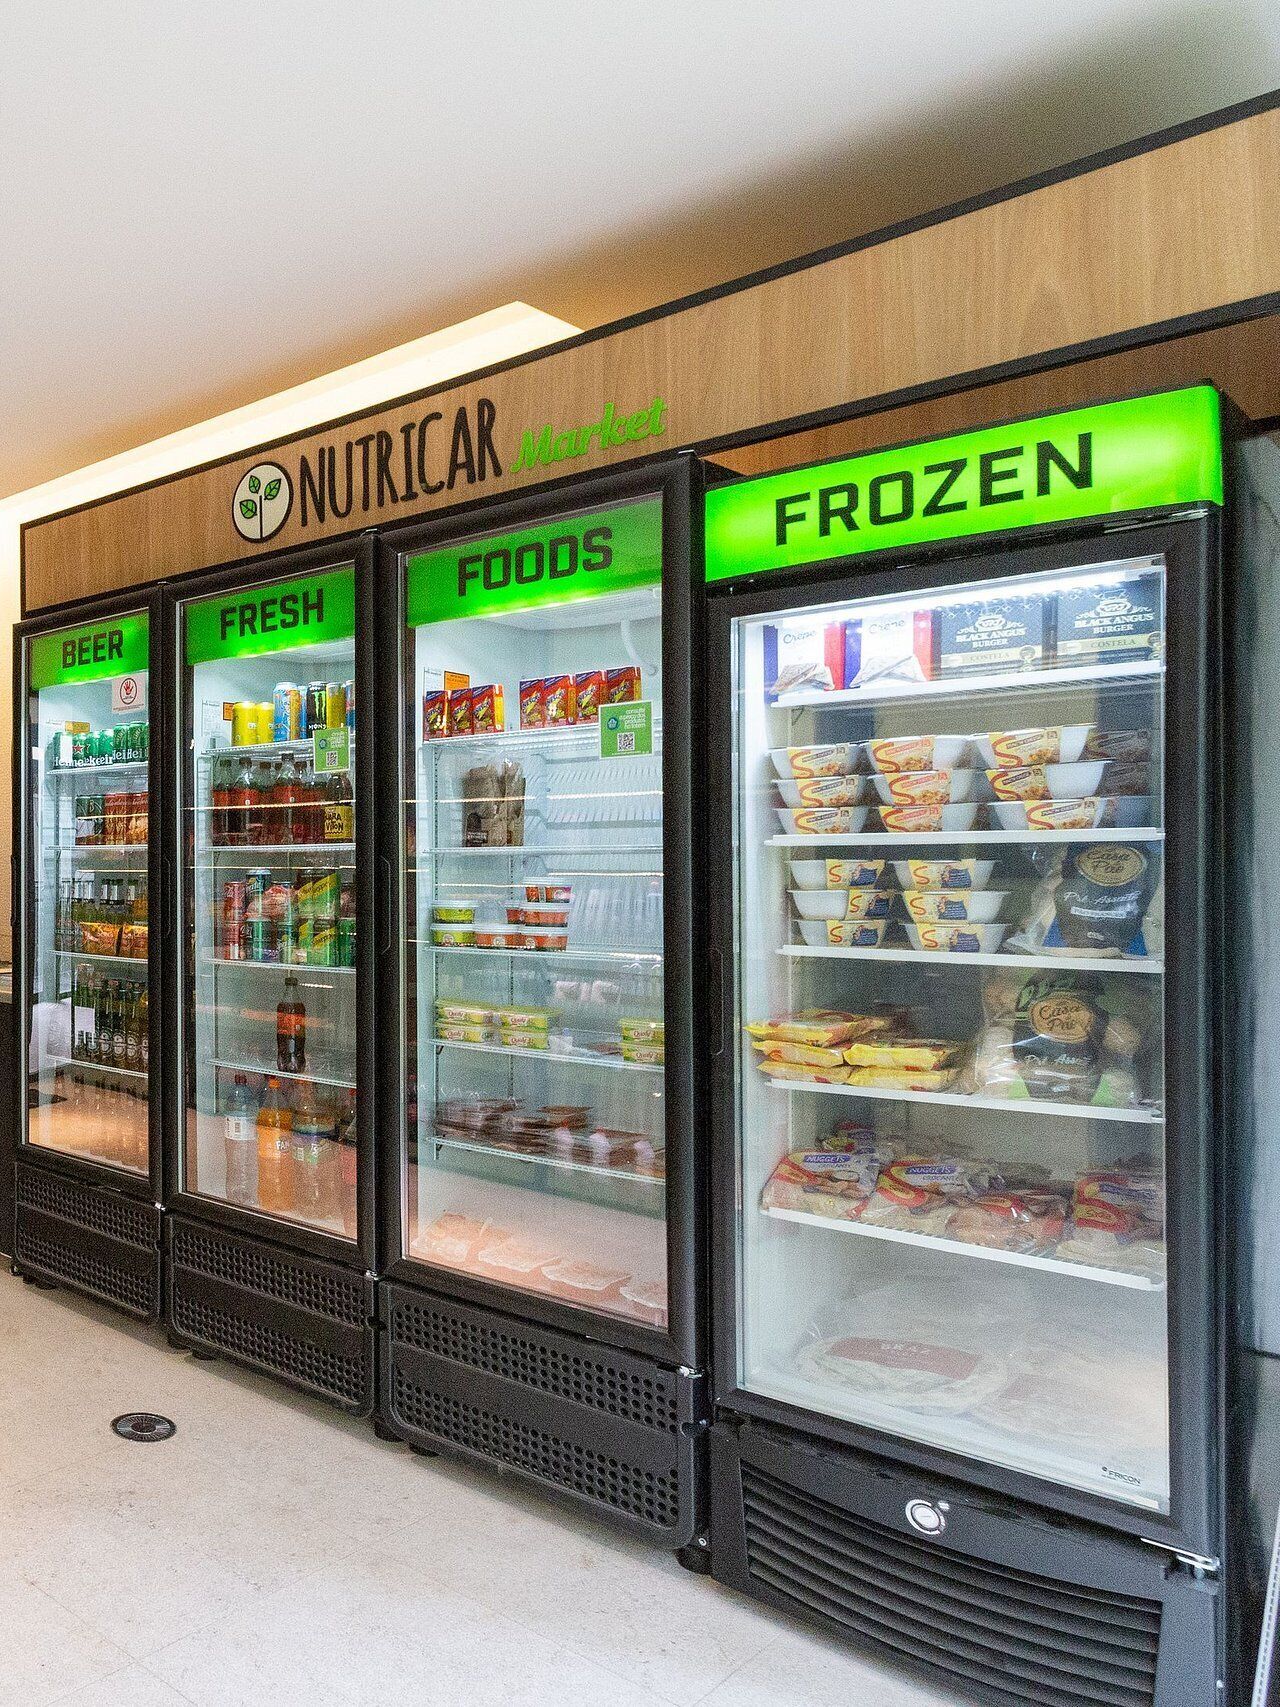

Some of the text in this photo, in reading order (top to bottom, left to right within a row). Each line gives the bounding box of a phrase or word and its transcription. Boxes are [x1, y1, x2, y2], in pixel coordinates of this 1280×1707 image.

[300, 396, 667, 527] NUTRICAR Market
[775, 431, 1093, 547] FROZEN
[458, 526, 613, 597] FOODS
[220, 588, 324, 641] FRESH
[1074, 612, 1155, 628] BLACK ANGUS
[990, 627, 1027, 639] ANGUS
[1093, 623, 1134, 634] BURGER
[62, 629, 124, 669] BEER
[972, 638, 1008, 648] BURGER
[1091, 638, 1136, 648] COSTELA
[1108, 1470, 1141, 1484] FRICON
